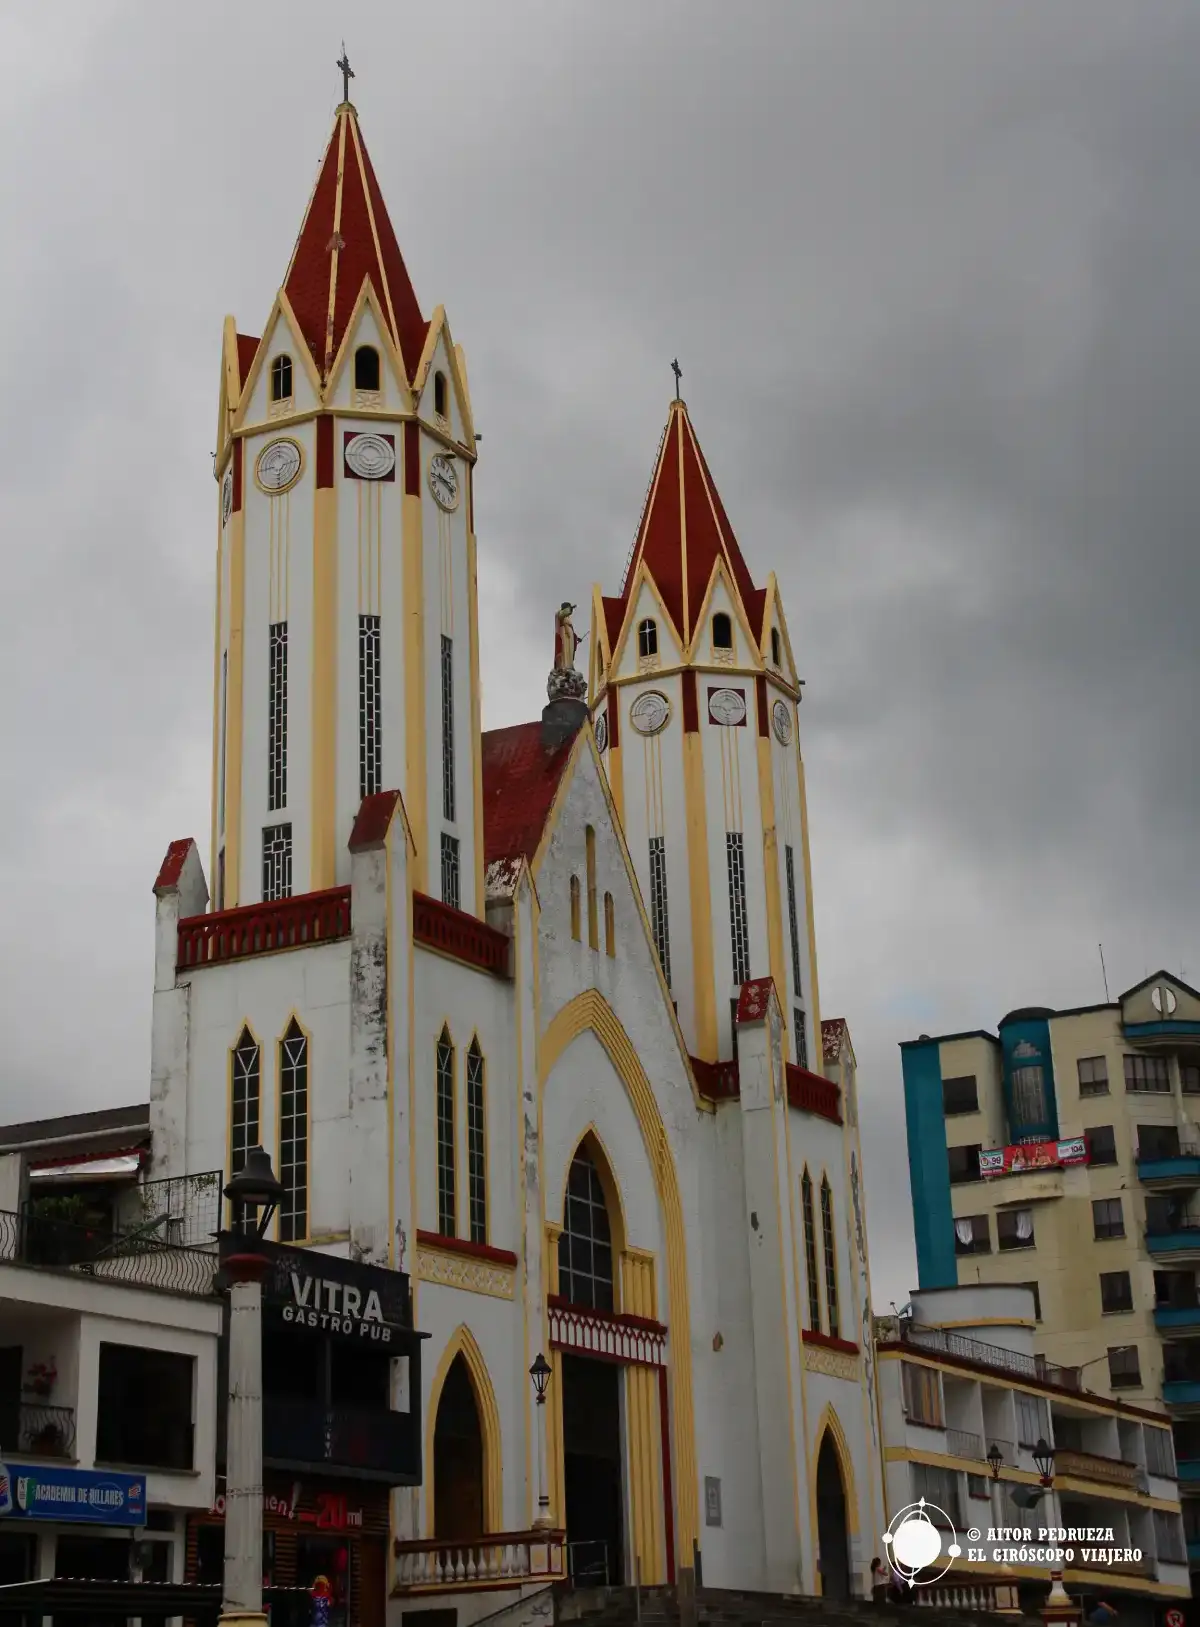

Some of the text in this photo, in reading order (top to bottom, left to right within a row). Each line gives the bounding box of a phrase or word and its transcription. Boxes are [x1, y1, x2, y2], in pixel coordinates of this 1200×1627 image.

[991, 1156, 1001, 1165] 99
[289, 1271, 384, 1324] VITRA
[282, 1305, 392, 1343] GASTRO PUB
[35, 1484, 76, 1503] ACADEMIA
[77, 1487, 88, 1504] DE
[89, 1488, 125, 1506] BILLARES
